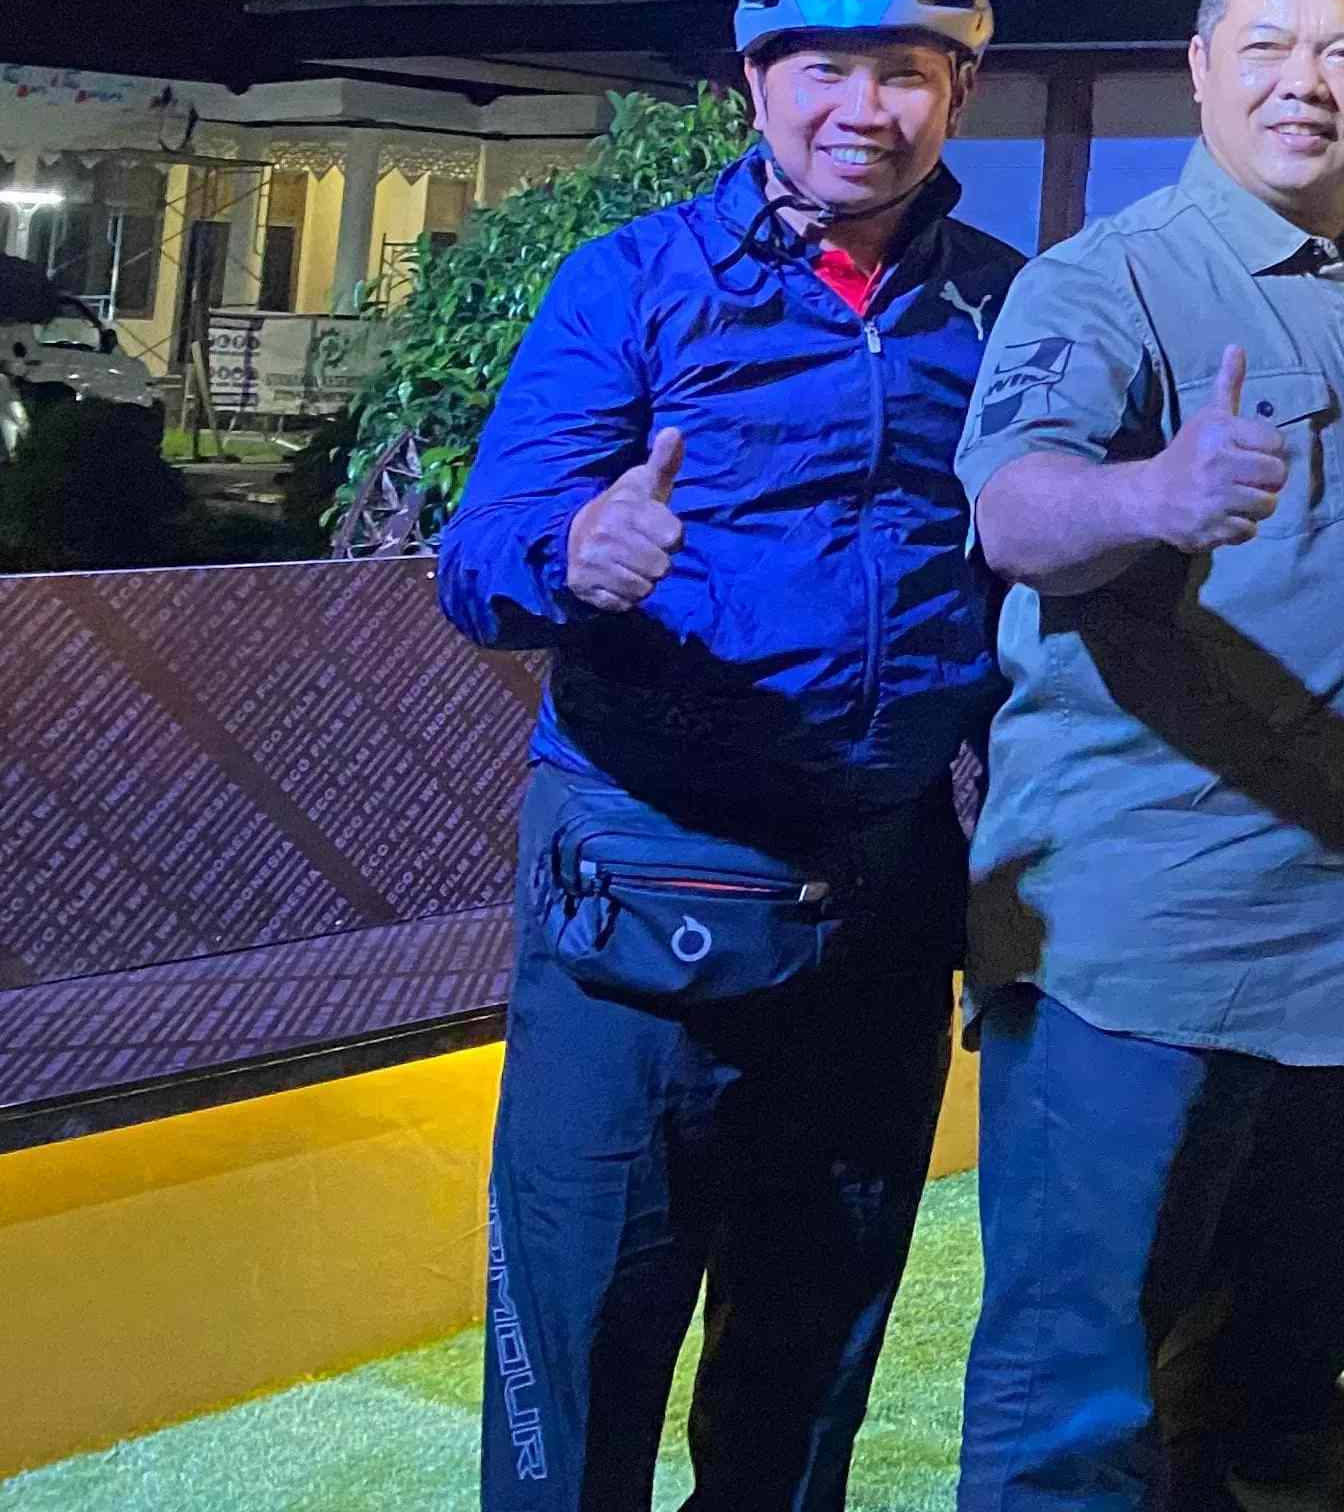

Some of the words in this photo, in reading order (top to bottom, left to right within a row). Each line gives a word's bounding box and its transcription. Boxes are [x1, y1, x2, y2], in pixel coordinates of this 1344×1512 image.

[70, 691, 155, 781] INDONESIA
[225, 699, 256, 733] ECO
[253, 729, 284, 763] ECO
[284, 690, 318, 729] FILM
[280, 758, 311, 792] ECO
[310, 717, 345, 758] FILM
[342, 692, 364, 718] WP
[334, 815, 363, 849] ECO
[363, 774, 397, 815] FILM
[395, 749, 415, 775] WP
[423, 661, 490, 742] INDONESIA
[307, 787, 338, 822] ECO
[338, 746, 371, 786] FILM
[368, 720, 389, 746] WP
[25, 850, 65, 895] FILM
[65, 821, 89, 849] WP
[86, 910, 127, 954] FILM
[125, 882, 150, 910] WP
[160, 782, 239, 872] INDONESIA
[188, 812, 267, 901] INDONESIA
[361, 843, 390, 879] ECO
[388, 802, 421, 843] FILM
[419, 776, 440, 803] WP
[386, 871, 415, 905] ECO
[413, 829, 447, 870] FILM
[444, 805, 465, 830] WP
[439, 857, 472, 898] FILM
[469, 831, 490, 857] WP
[21, 927, 58, 965] ECO
[57, 881, 98, 925] FILM
[94, 852, 120, 881] WP
[218, 841, 294, 930] INDONESIA
